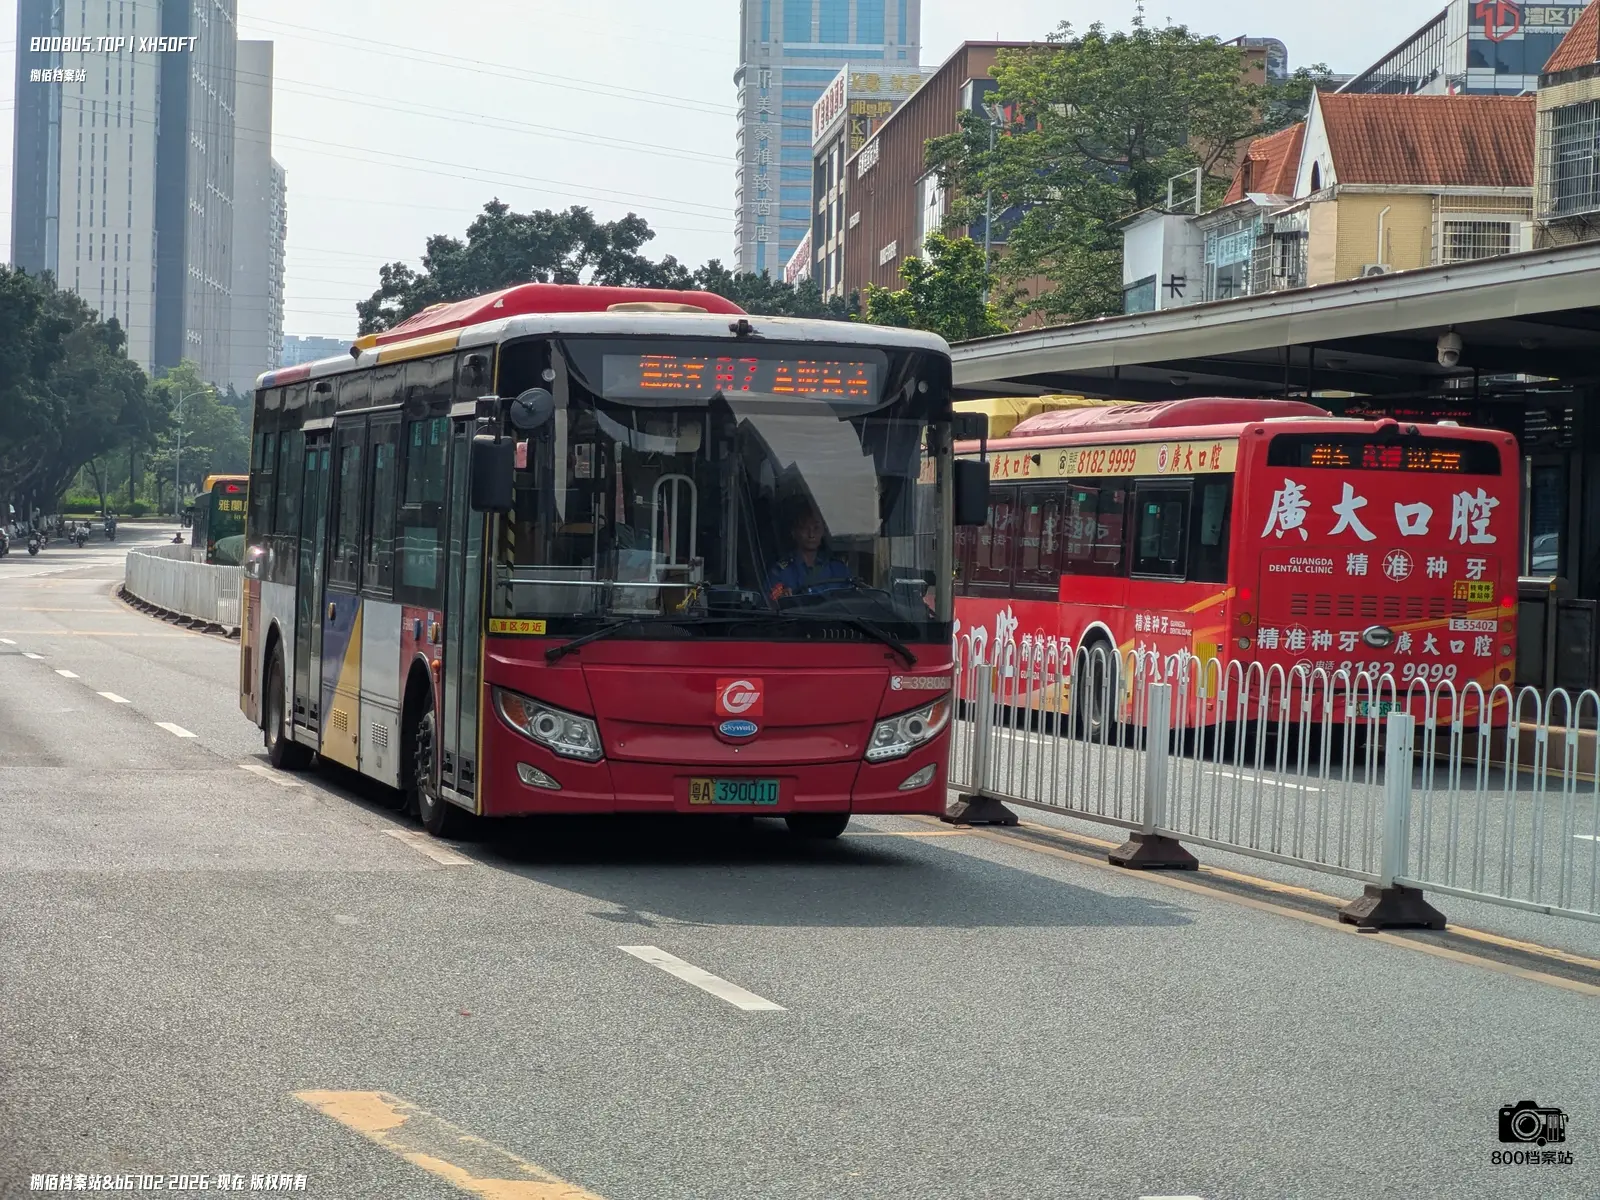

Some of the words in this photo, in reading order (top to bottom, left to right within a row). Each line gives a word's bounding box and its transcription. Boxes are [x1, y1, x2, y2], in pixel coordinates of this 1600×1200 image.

[992, 453, 1031, 478] 廣大口腔
[1077, 450, 1106, 474] 8182
[1107, 448, 1137, 472] 9999
[1170, 443, 1223, 472] 廣大口腔
[1261, 478, 1500, 546] 廣大口腔
[1268, 564, 1303, 573] DENTAL
[1304, 565, 1333, 574] CLINIC
[1289, 557, 1334, 566] GUANGDA
[1346, 552, 1487, 580] 精准种牙
[500, 620, 542, 632] 盲区勿近
[1452, 620, 1494, 631] E-55402
[1257, 627, 1360, 652] 精准种牙
[1393, 631, 1494, 656] 廣大口腔
[1401, 663, 1457, 683] 9999
